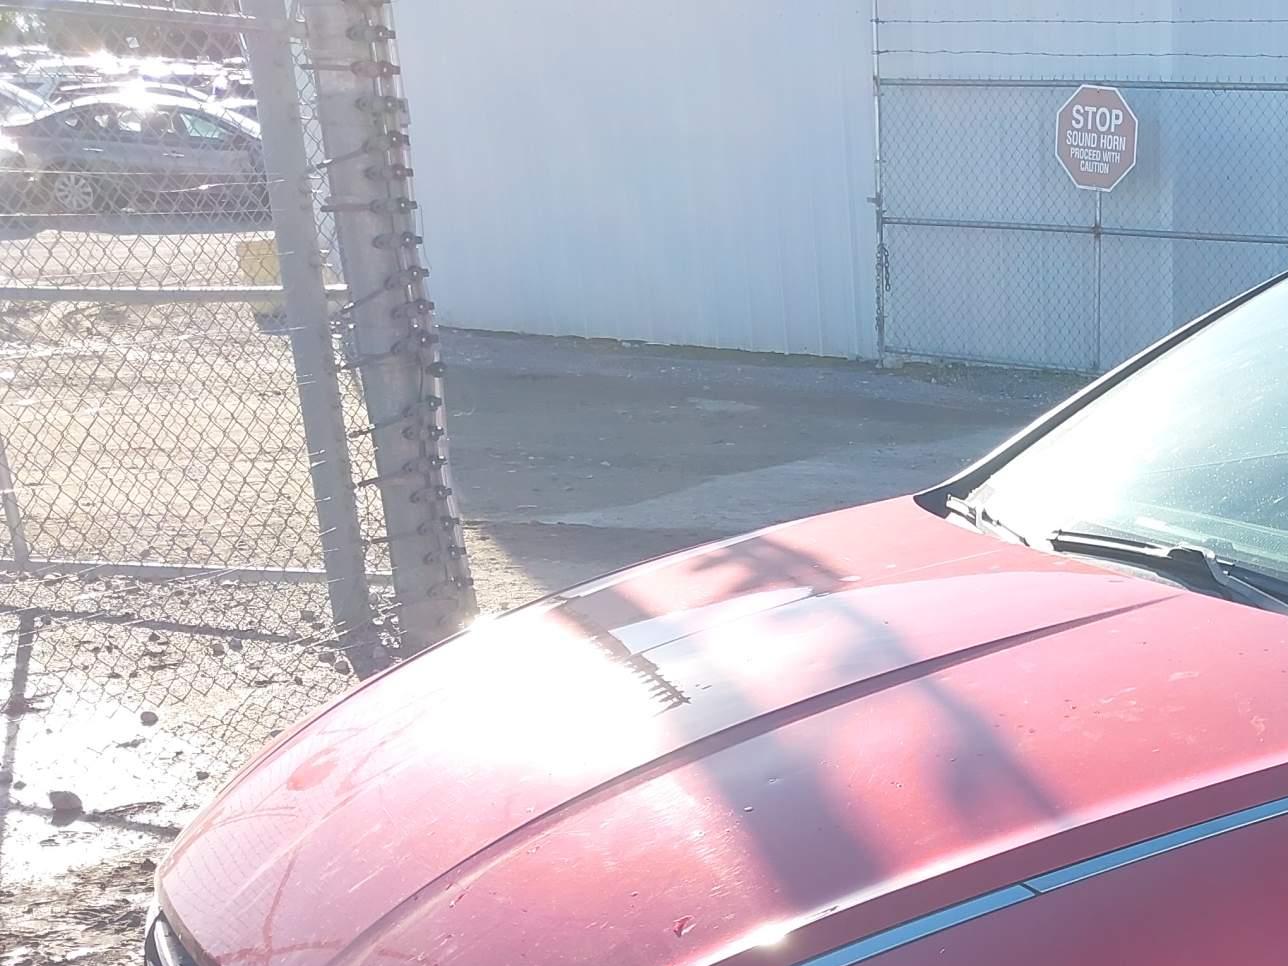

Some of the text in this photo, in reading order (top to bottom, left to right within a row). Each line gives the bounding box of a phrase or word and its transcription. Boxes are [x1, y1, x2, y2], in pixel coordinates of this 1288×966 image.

[1072, 104, 1123, 132] STOP
[1066, 130, 1127, 151] SOUND HORN
[1070, 147, 1121, 164] PROCEED WITH
[1080, 160, 1110, 174] CAUTION
